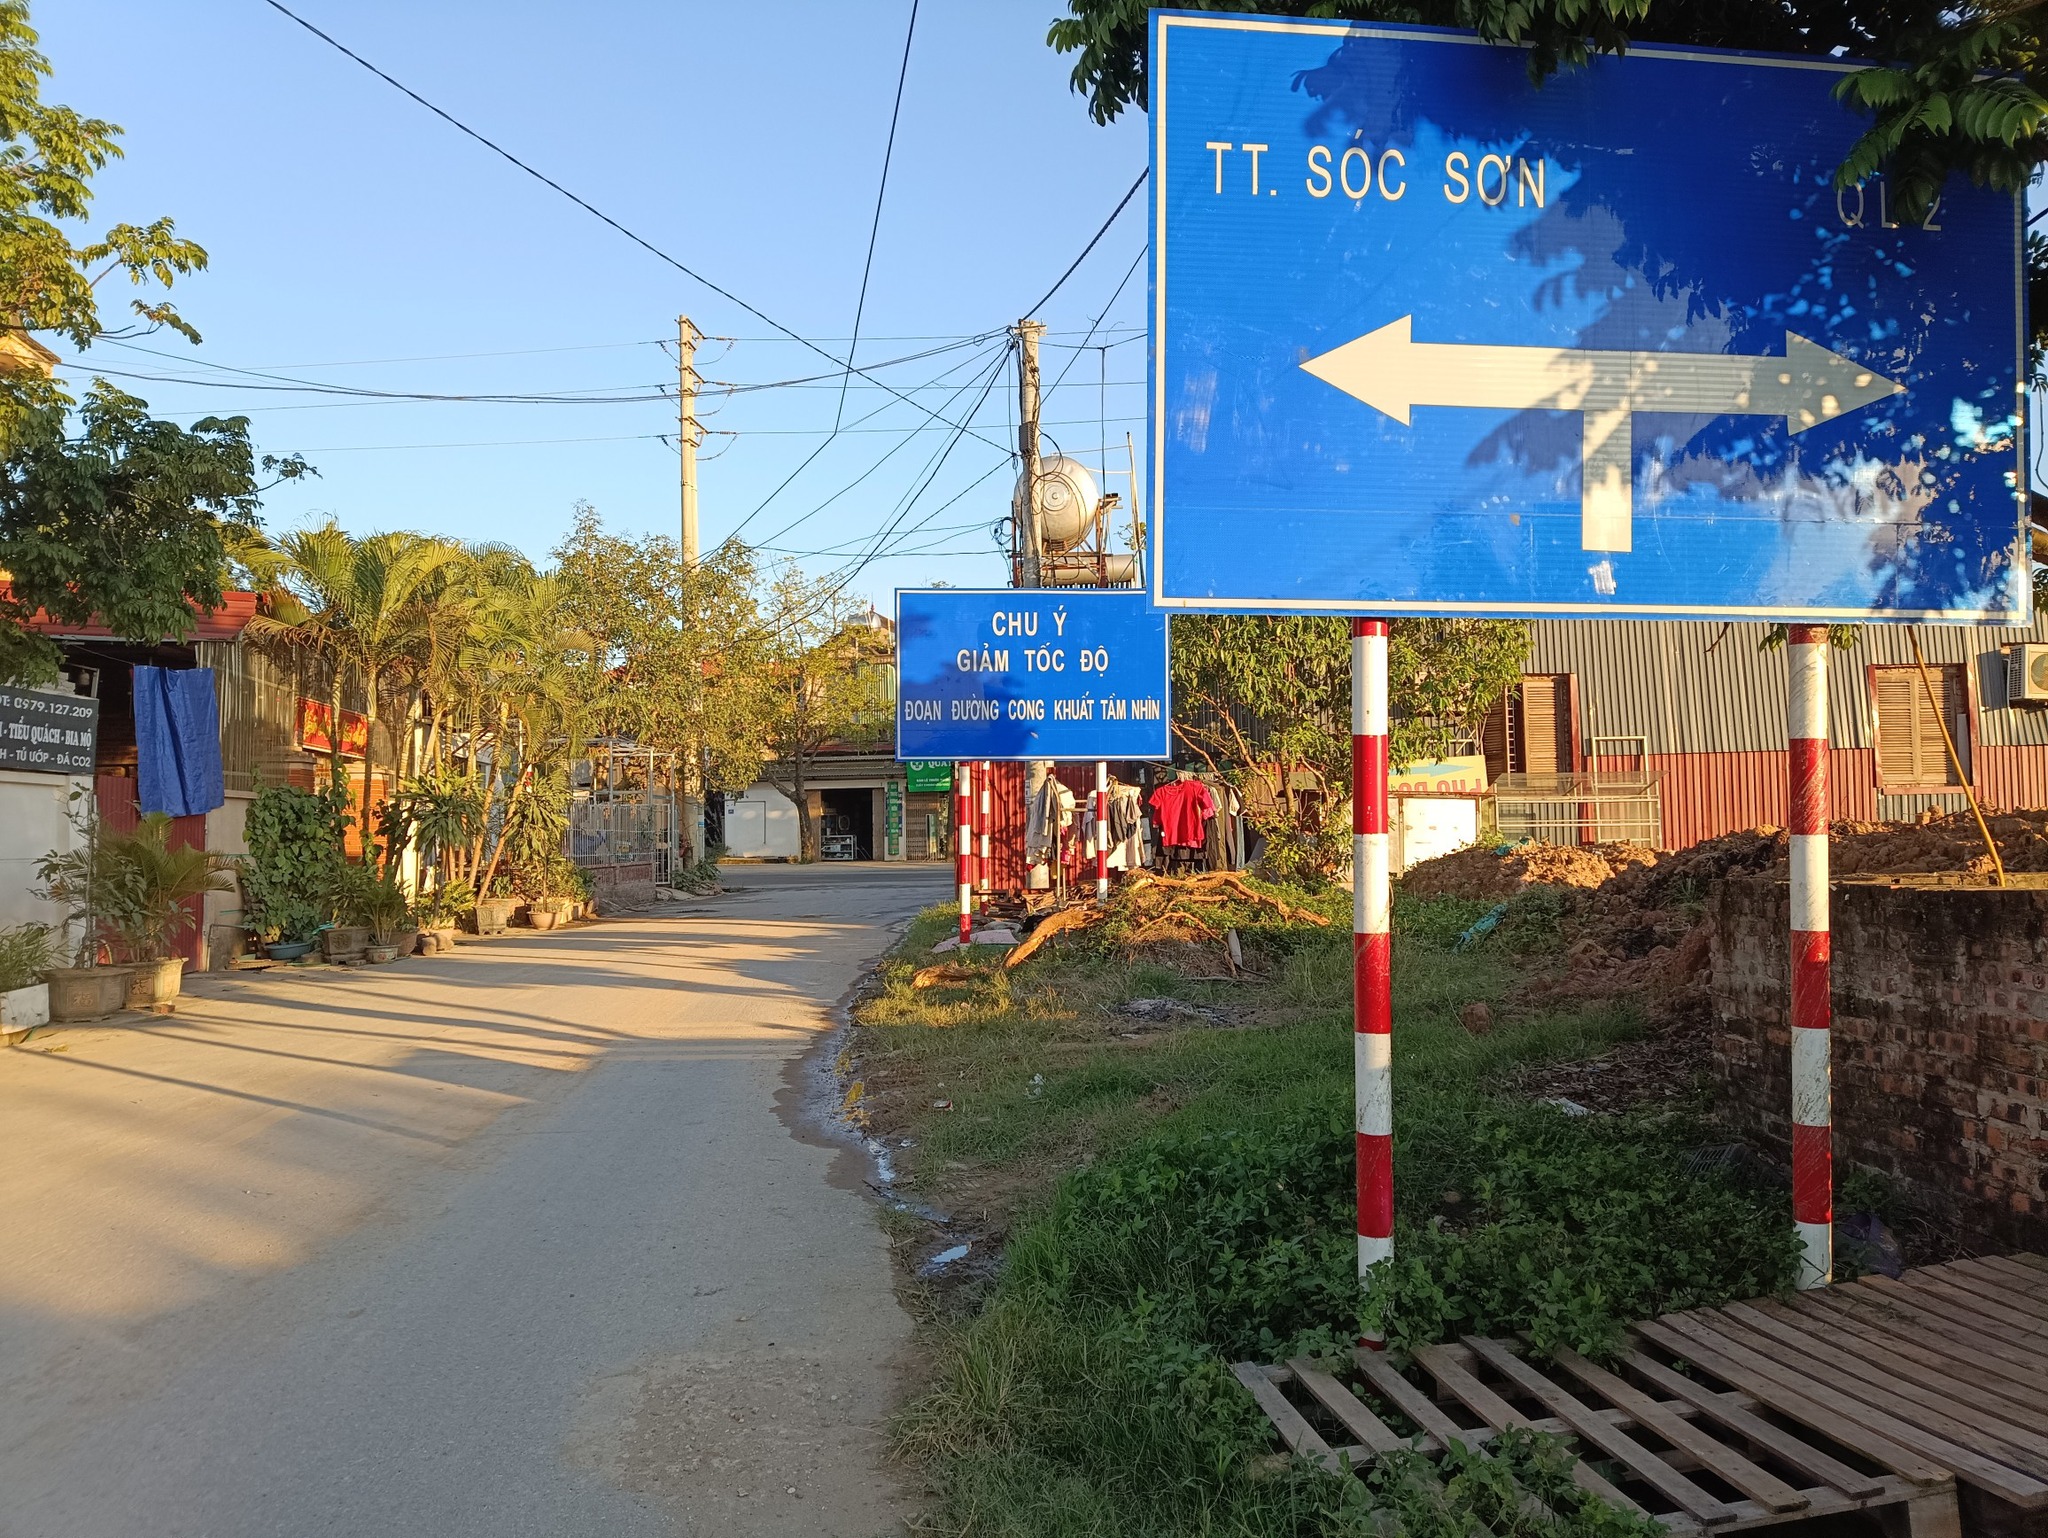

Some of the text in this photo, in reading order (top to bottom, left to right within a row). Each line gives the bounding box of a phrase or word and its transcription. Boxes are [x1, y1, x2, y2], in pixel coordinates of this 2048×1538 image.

[1205, 128, 1545, 208] TT. SÓC SƠN
[992, 604, 1068, 637] CHU Ý
[956, 641, 1109, 678] GIẢM TỐC ĐỘ
[14, 697, 93, 718] 0979.127.209
[905, 691, 1161, 725] ĐOẠN ĐƯỜNG CONG KHUẤT TẦM NHÌN
[8, 715, 30, 741] TIỂU
[31, 723, 61, 745] QUÁCH
[65, 730, 79, 746] BIA
[80, 728, 92, 751] MỘ
[16, 746, 27, 761] TỦ
[56, 751, 70, 765] ĐÁ
[72, 755, 91, 768] CO2
